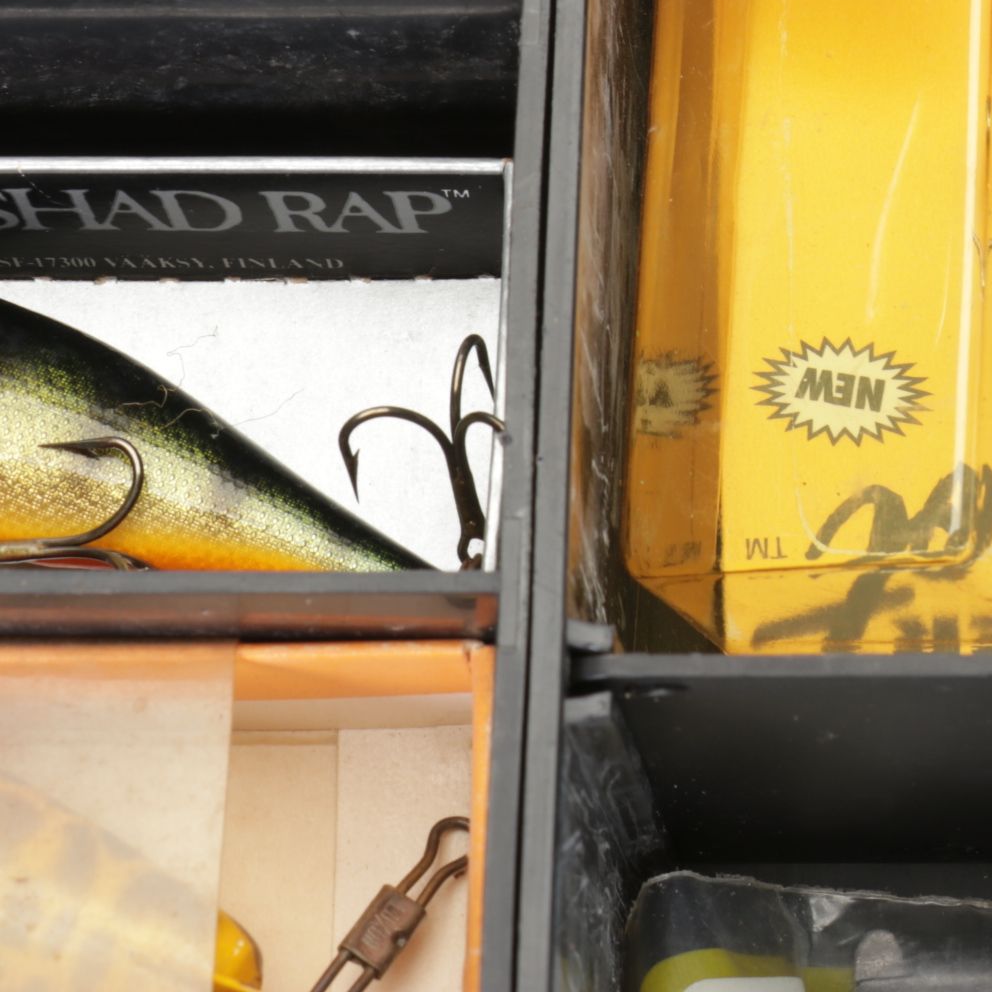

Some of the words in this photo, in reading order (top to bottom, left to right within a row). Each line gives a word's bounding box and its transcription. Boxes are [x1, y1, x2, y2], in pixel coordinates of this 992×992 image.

[0, 188, 242, 232] SHAD
[258, 190, 452, 234] RAP
[223, 257, 343, 269] FINLAND
[795, 367, 885, 414] NEW
